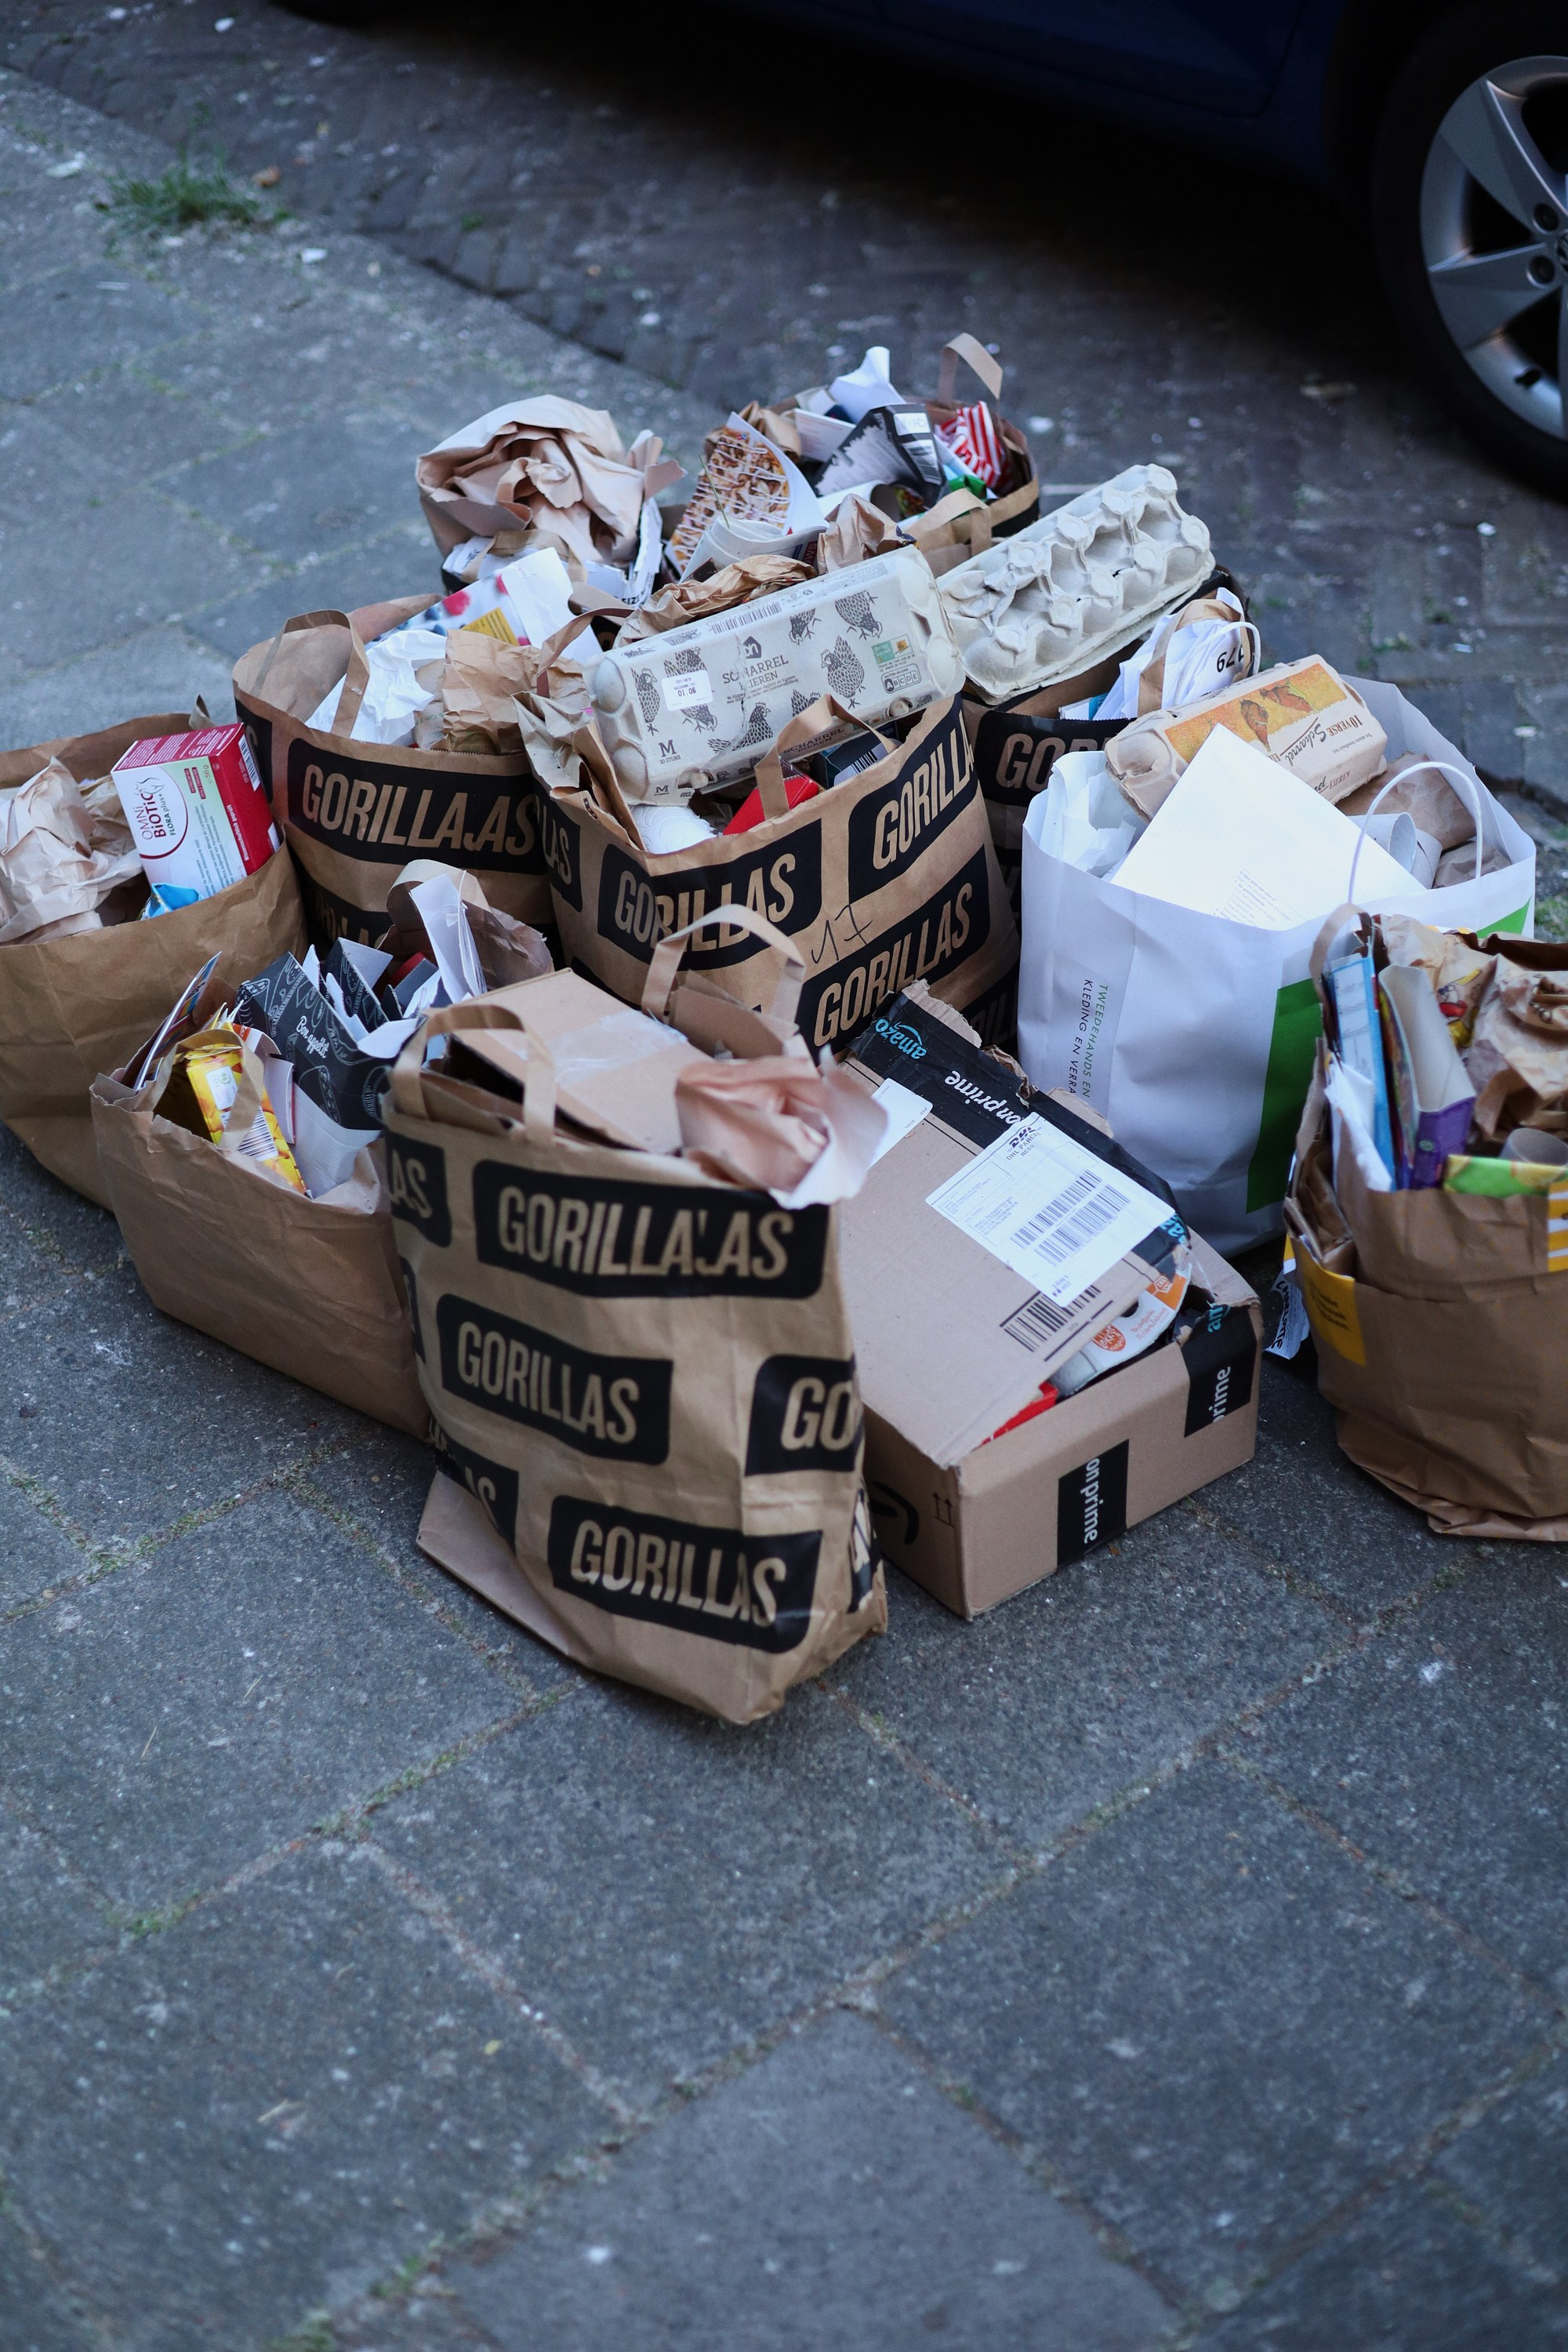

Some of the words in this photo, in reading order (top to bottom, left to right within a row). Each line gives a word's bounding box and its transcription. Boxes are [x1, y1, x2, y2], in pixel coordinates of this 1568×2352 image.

[658, 739, 678, 758] M
[1325, 717, 1353, 738] VERSE
[165, 814, 176, 836] FLORA
[615, 853, 797, 952] GORILLAS
[813, 882, 973, 1047] GORILLAS
[296, 1015, 310, 1038] Bon
[1078, 978, 1094, 1033] KLEDING
[1073, 1036, 1083, 1055] EN
[1083, 984, 1108, 1080] TWEEDEHANDS
[1081, 1083, 1091, 1098] EN
[1005, 1148, 1020, 1161] DHL
[1018, 1129, 1041, 1150] PARCEL
[458, 1321, 640, 1444] GORILLAS
[1083, 1457, 1101, 1545] onprime
[570, 1519, 787, 1628] GORILLAS
